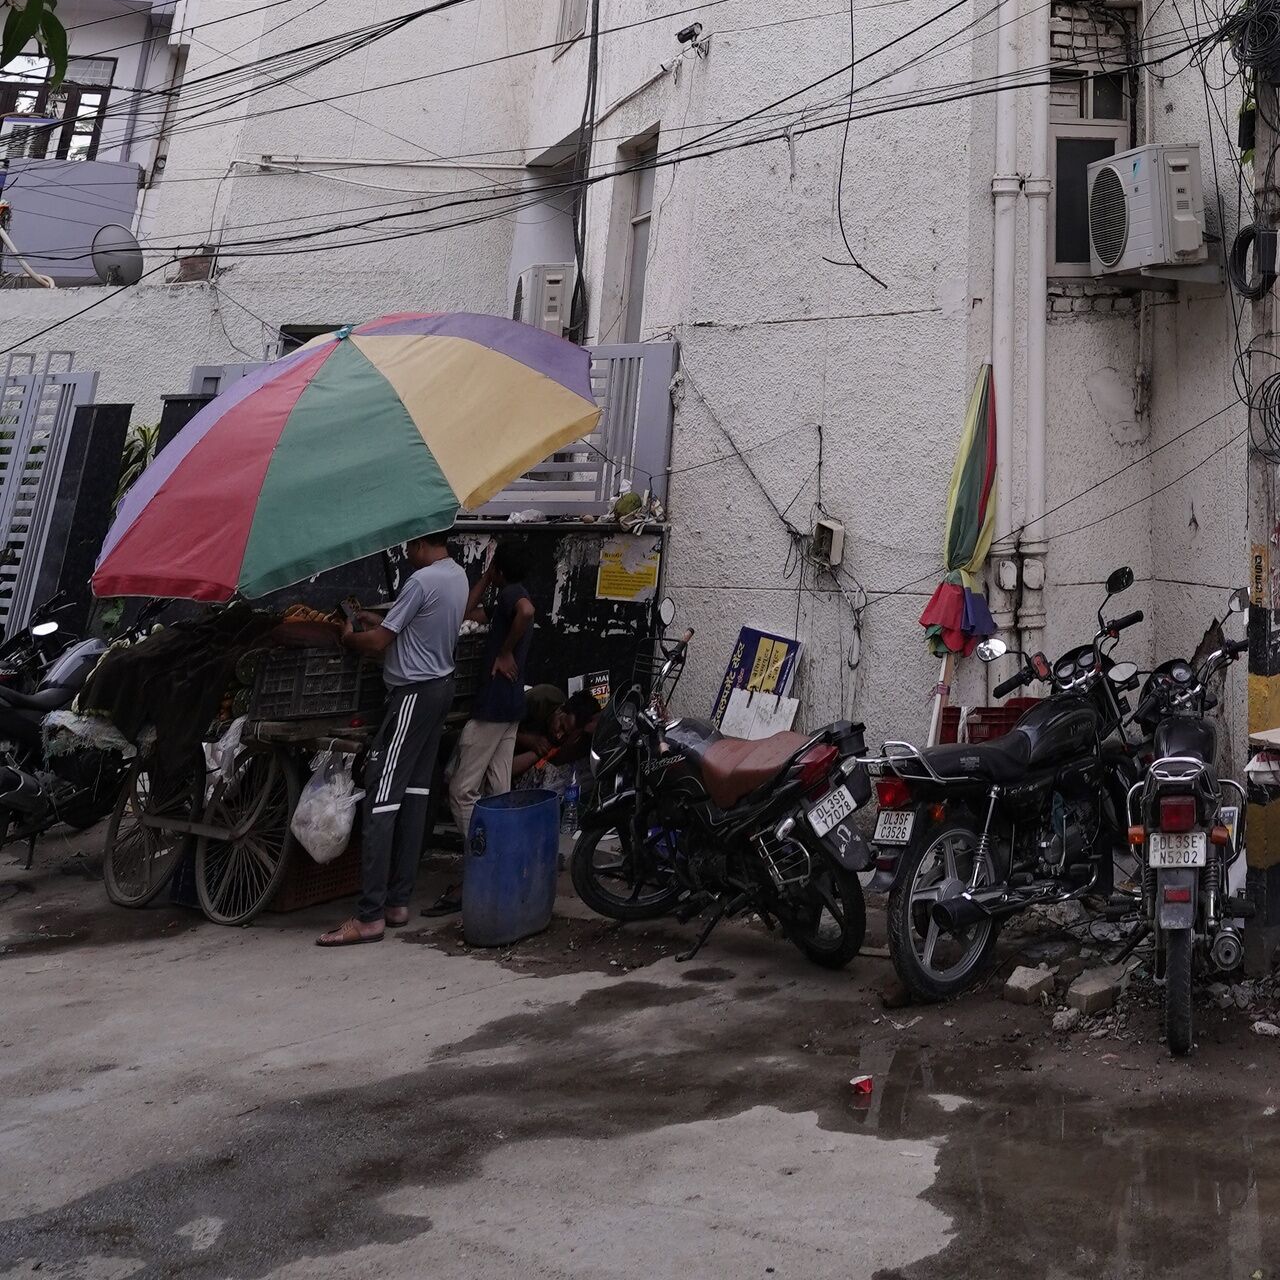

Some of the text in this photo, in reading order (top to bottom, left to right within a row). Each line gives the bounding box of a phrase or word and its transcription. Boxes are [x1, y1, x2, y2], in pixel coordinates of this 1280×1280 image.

[816, 790, 845, 819] DL3SB
[822, 800, 852, 829] Y7078
[884, 813, 910, 825] DL3SF
[881, 826, 907, 839] C3526
[1160, 835, 1198, 850] DL3SE
[1160, 850, 1198, 864] N5202
